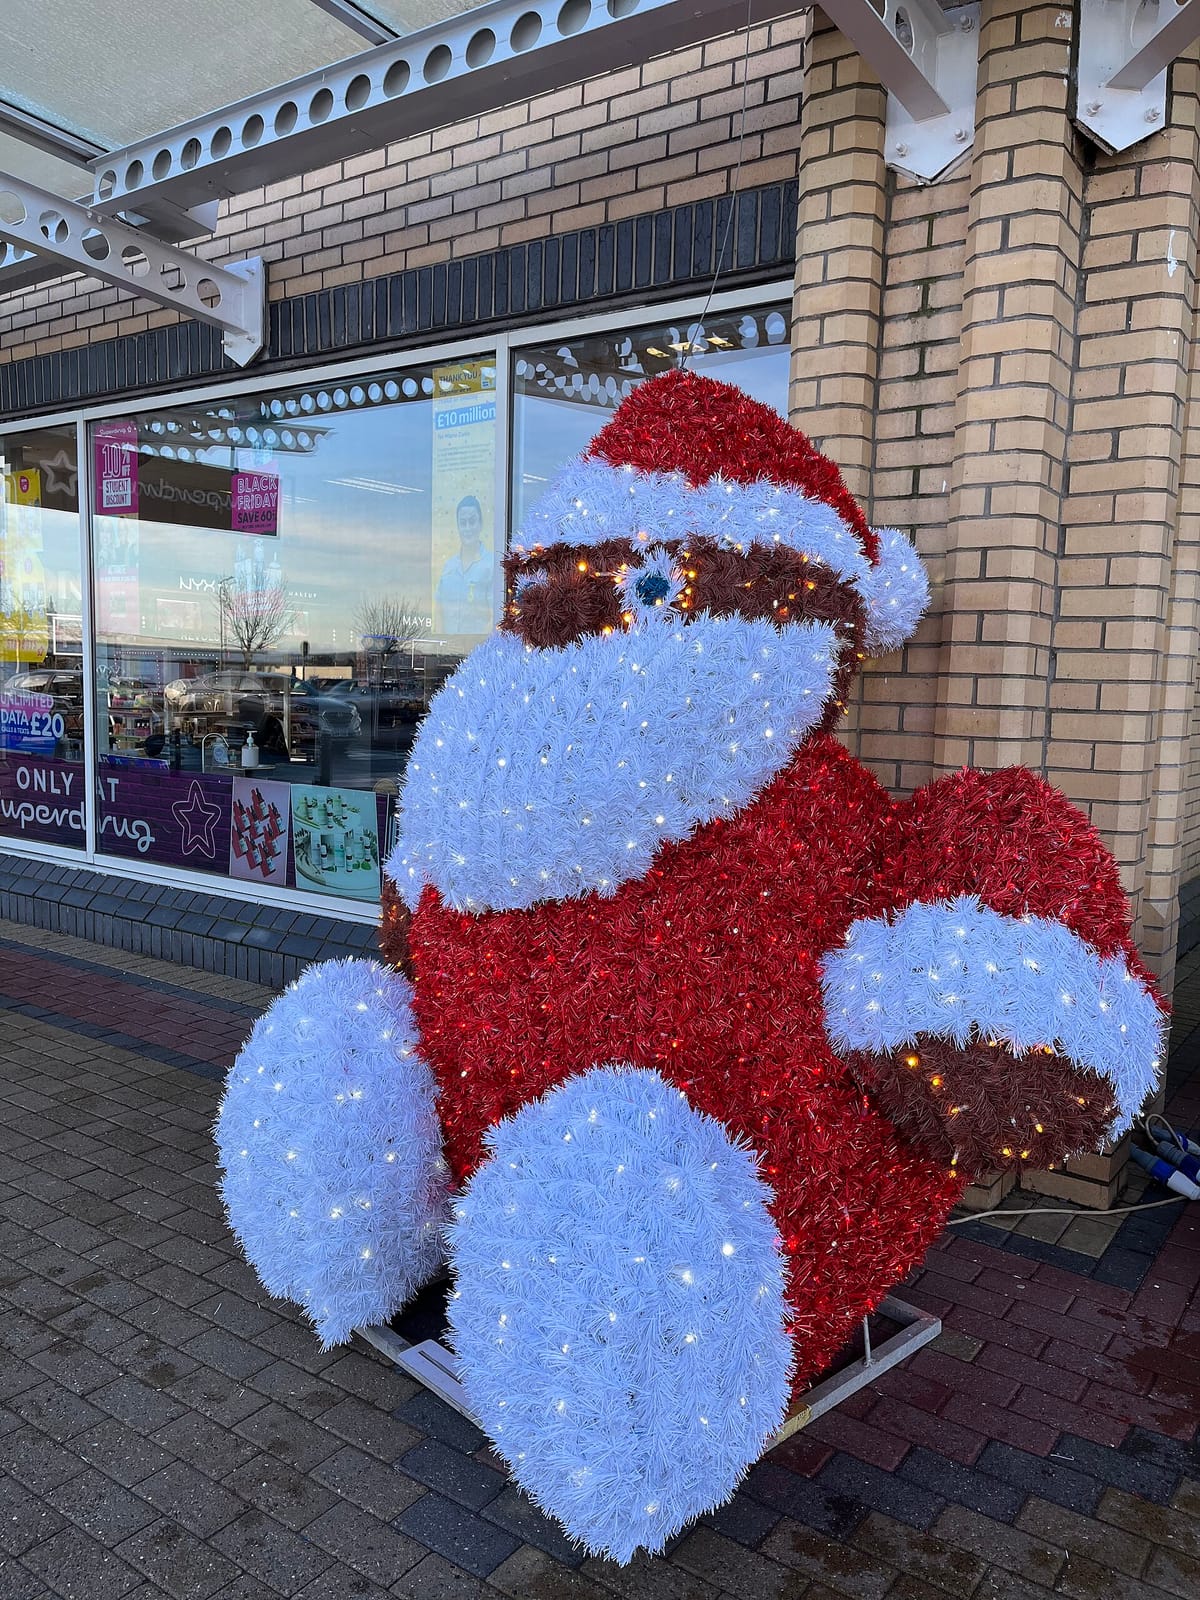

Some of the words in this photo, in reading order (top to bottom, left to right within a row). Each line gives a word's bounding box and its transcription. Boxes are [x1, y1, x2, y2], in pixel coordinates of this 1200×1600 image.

[439, 372, 463, 384] THANK
[463, 370, 478, 380] YOU
[437, 411, 458, 429] £10
[459, 406, 496, 425] million
[106, 480, 129, 493] STUDENT
[237, 475, 278, 494] BLACK
[105, 494, 128, 505] DISCOUNT
[237, 492, 278, 510] FRIDAY
[237, 511, 259, 523] SAVE
[179, 576, 215, 593] NYX
[402, 615, 432, 628] MAYB
[0, 692, 54, 709] UNLIMITED
[0, 708, 29, 726] DATA
[30, 711, 65, 738] £20
[16, 766, 74, 796] ONLY
